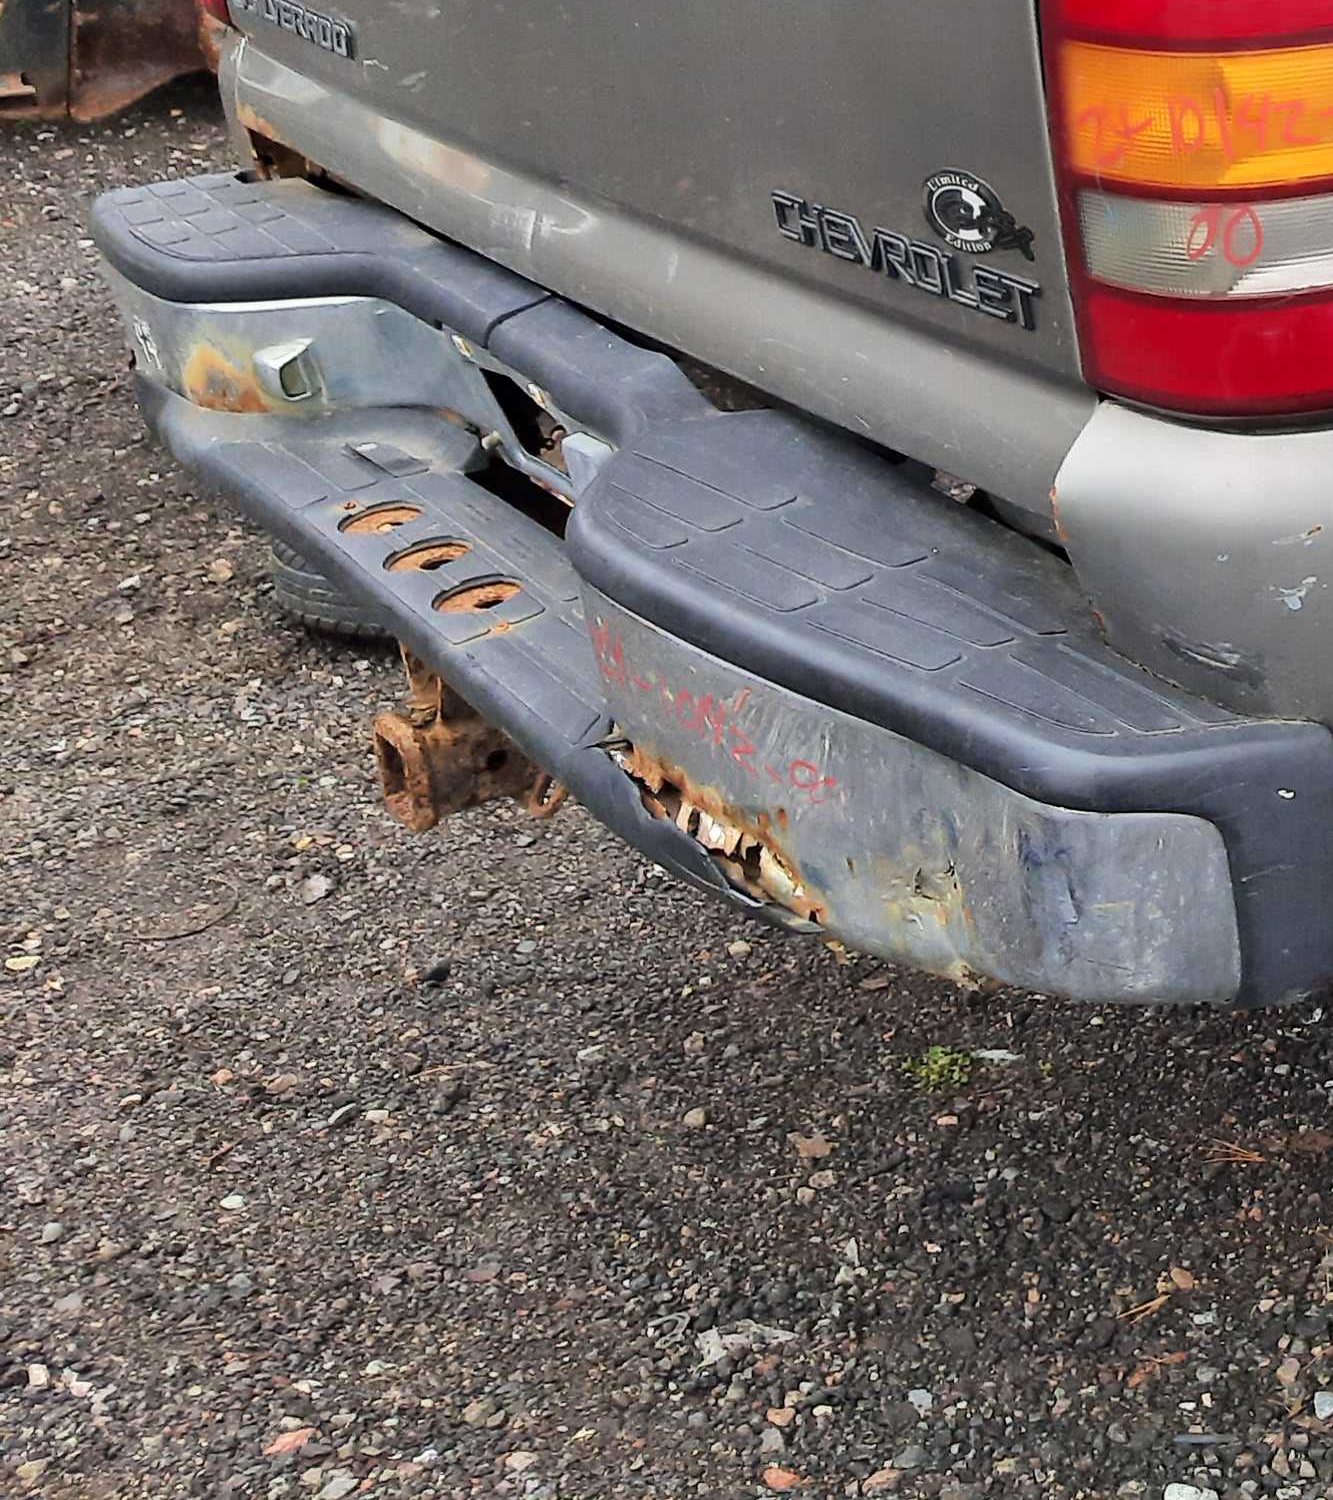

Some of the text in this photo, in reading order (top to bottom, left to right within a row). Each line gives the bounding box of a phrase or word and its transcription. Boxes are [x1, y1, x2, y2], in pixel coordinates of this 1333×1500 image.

[926, 173, 980, 193] Limited
[944, 232, 993, 253] Edition
[770, 188, 1041, 332] CHEVROLET
